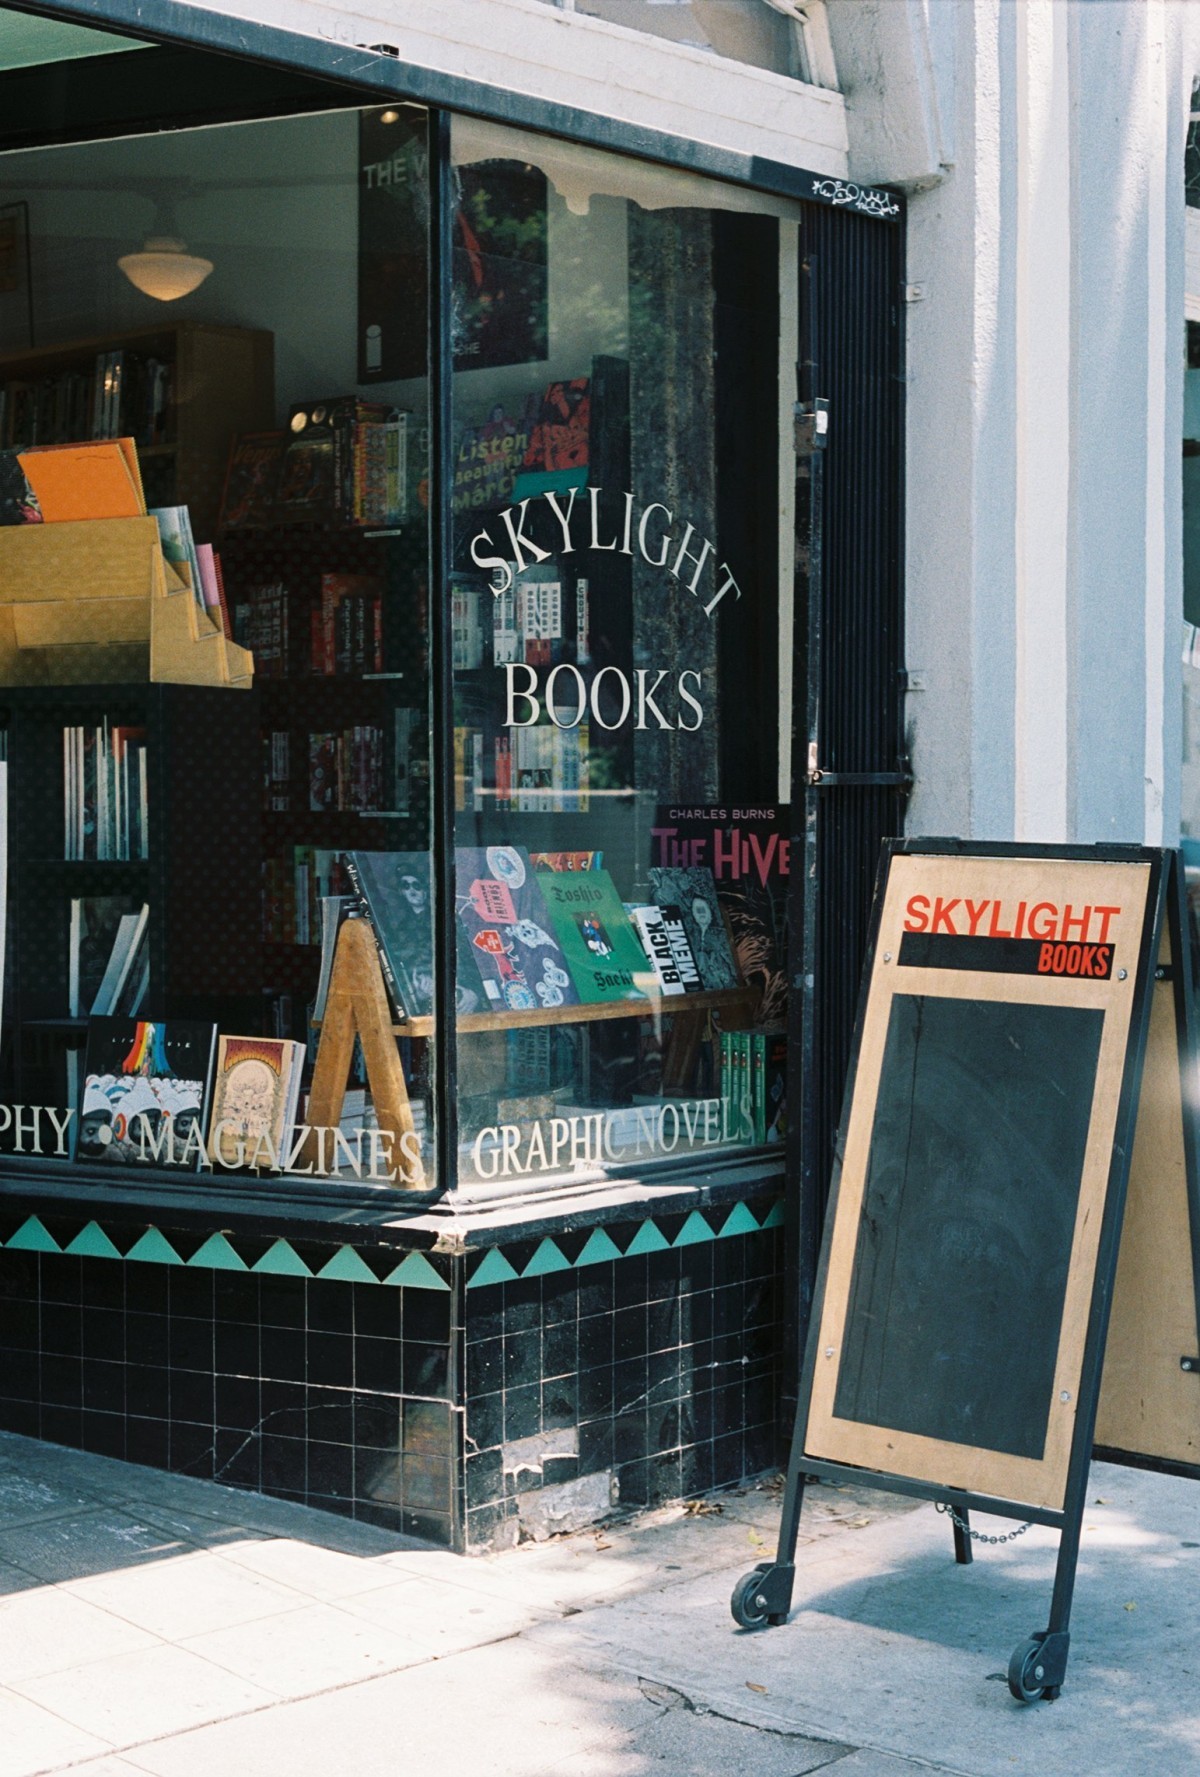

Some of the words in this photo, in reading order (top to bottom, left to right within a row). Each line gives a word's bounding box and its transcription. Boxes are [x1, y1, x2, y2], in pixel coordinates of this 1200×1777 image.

[362, 157, 407, 189] THE
[454, 453, 523, 486] Beautifu
[458, 432, 528, 463] Listen
[469, 485, 743, 618] SKYLIGHT
[501, 662, 703, 732] BOOKS
[669, 808, 727, 820] CHARLES
[732, 808, 776, 820] BURNS
[650, 827, 707, 868] THE
[713, 827, 791, 889] HIVE
[551, 885, 603, 904] Toshio
[903, 894, 1121, 944] SKYLIGHT
[645, 920, 681, 984] BLACK
[665, 919, 700, 983] MEME
[1037, 943, 1110, 977] BOOKS
[137, 1112, 427, 1190] MAGAZINES
[473, 1112, 629, 1180] GRAPHIC
[635, 1091, 755, 1157] NOVELS
